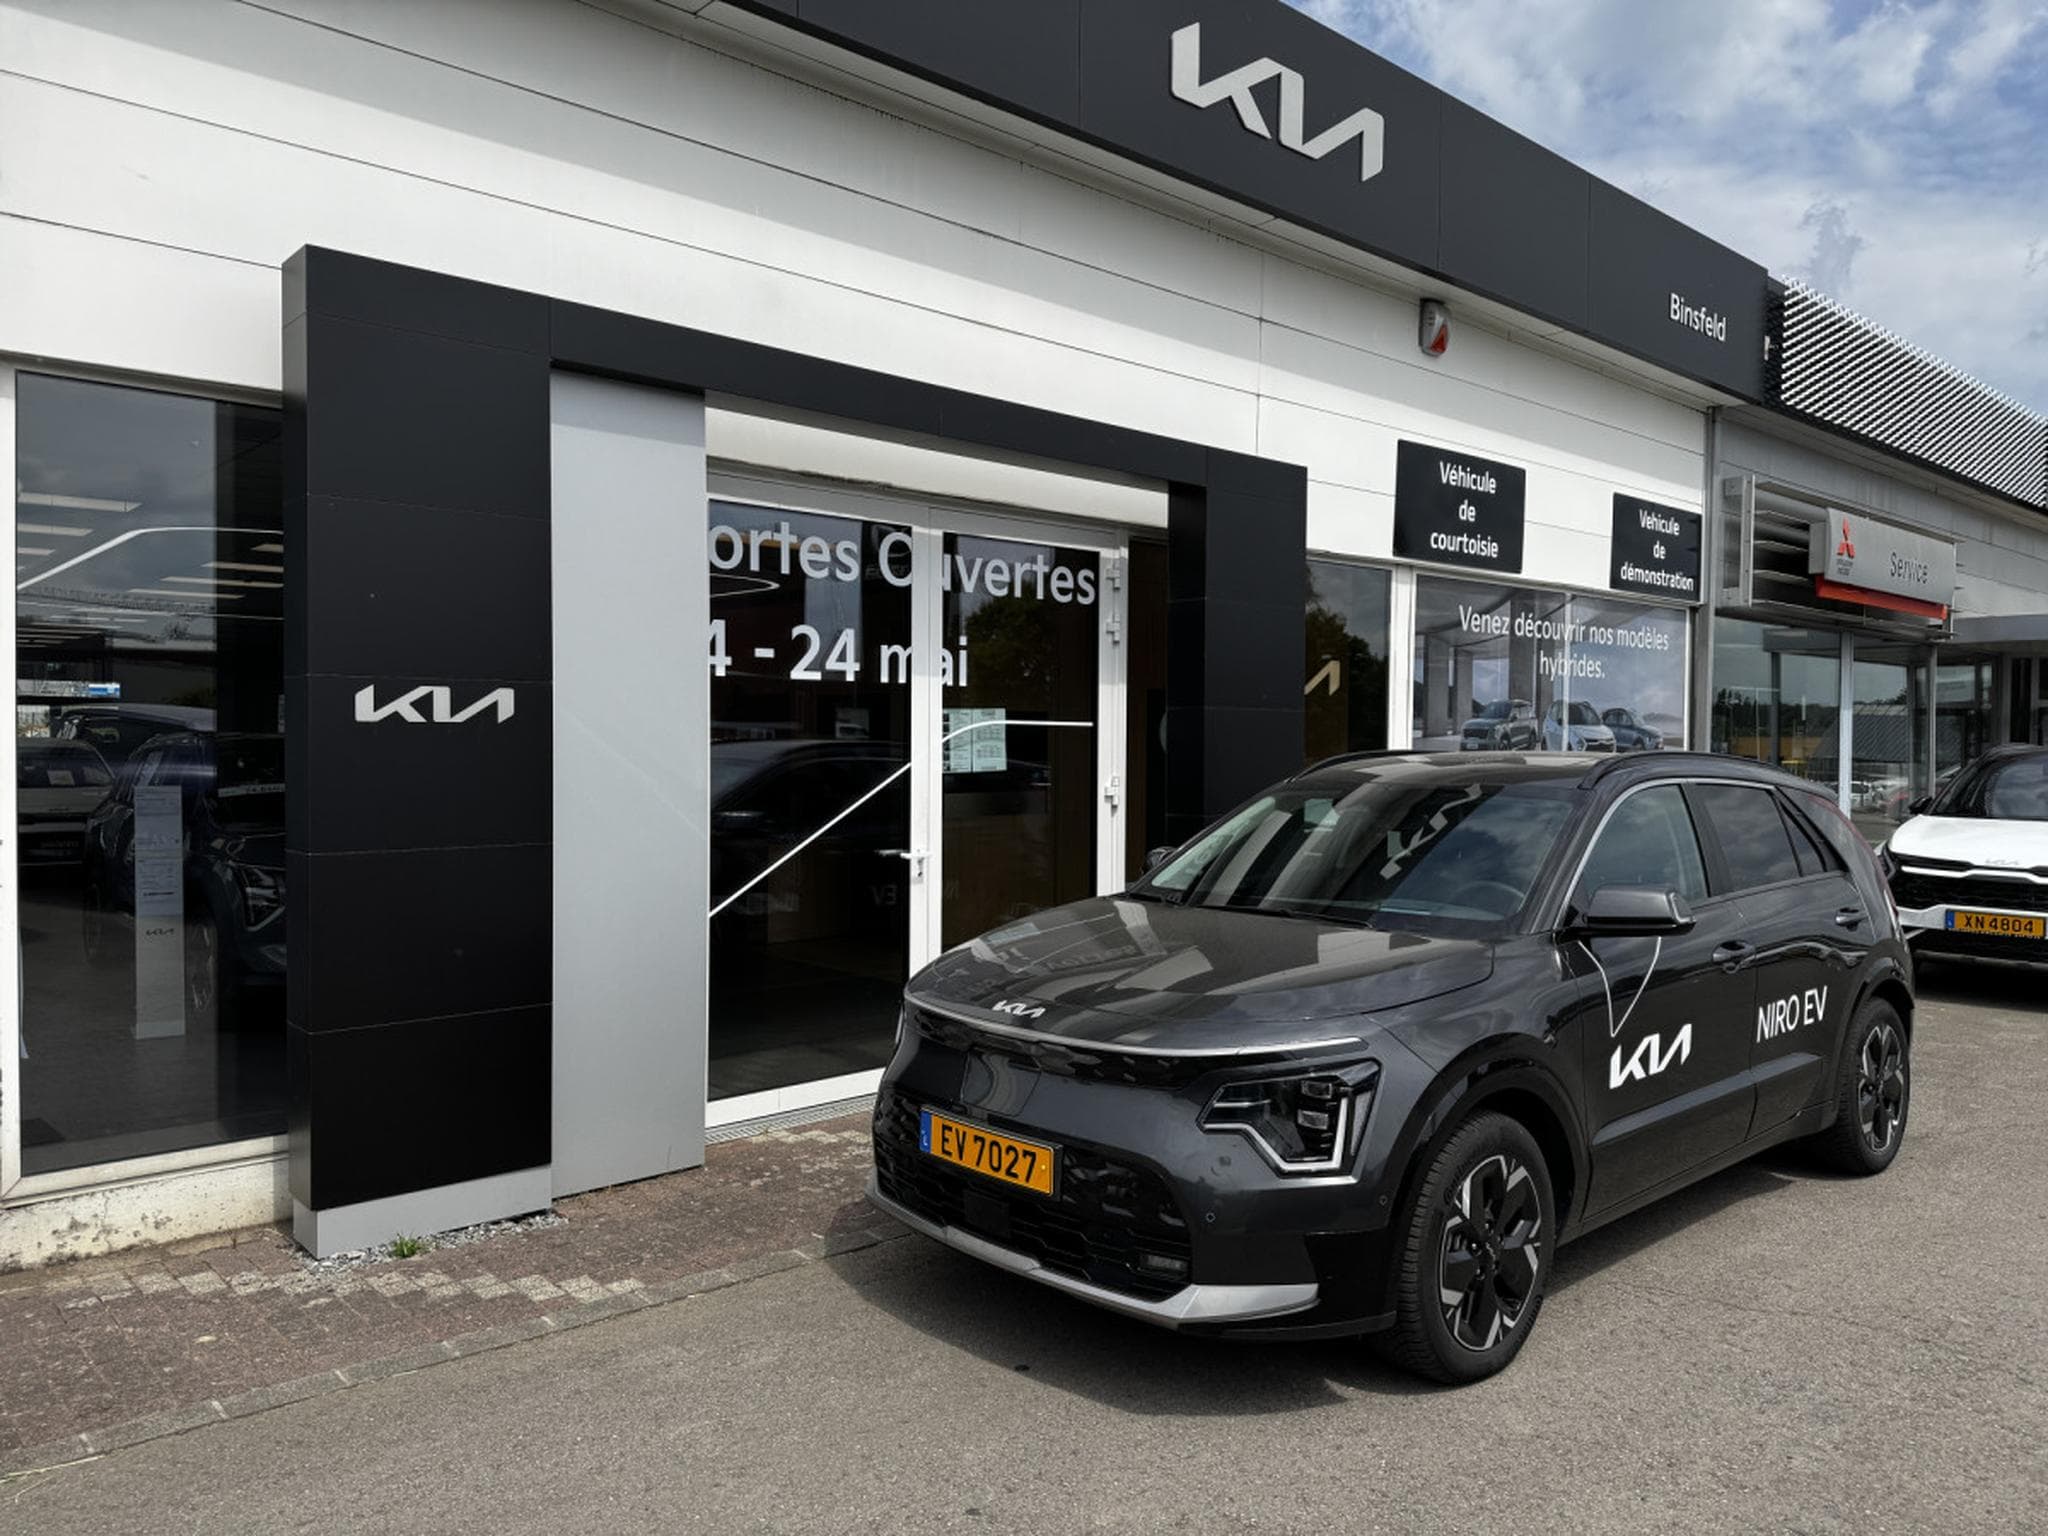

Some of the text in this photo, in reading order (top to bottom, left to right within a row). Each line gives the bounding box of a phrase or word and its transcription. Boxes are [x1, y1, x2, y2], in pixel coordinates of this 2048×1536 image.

[1171, 21, 1384, 182] KIA
[1670, 292, 1726, 341] Binsfeld
[1440, 460, 1496, 494] Véhicule
[1458, 499, 1476, 521] de
[1430, 532, 1498, 558] courtoisie
[1653, 540, 1666, 559] de
[1620, 560, 1694, 592] démonstration
[1890, 551, 1929, 585] Service
[1459, 605, 1670, 650] Venez découvrir nos modèles
[754, 647, 775, 658] -
[790, 624, 860, 683] 24
[1539, 650, 1606, 681] hybrides.
[355, 684, 514, 724] KIA
[1964, 914, 2034, 933] XN 4804
[992, 1000, 1046, 1018] KIA
[1756, 985, 1828, 1044] NIRO EV
[1609, 1023, 1692, 1089] KIA
[941, 1123, 967, 1162] EV
[973, 1134, 1037, 1183] 7027
